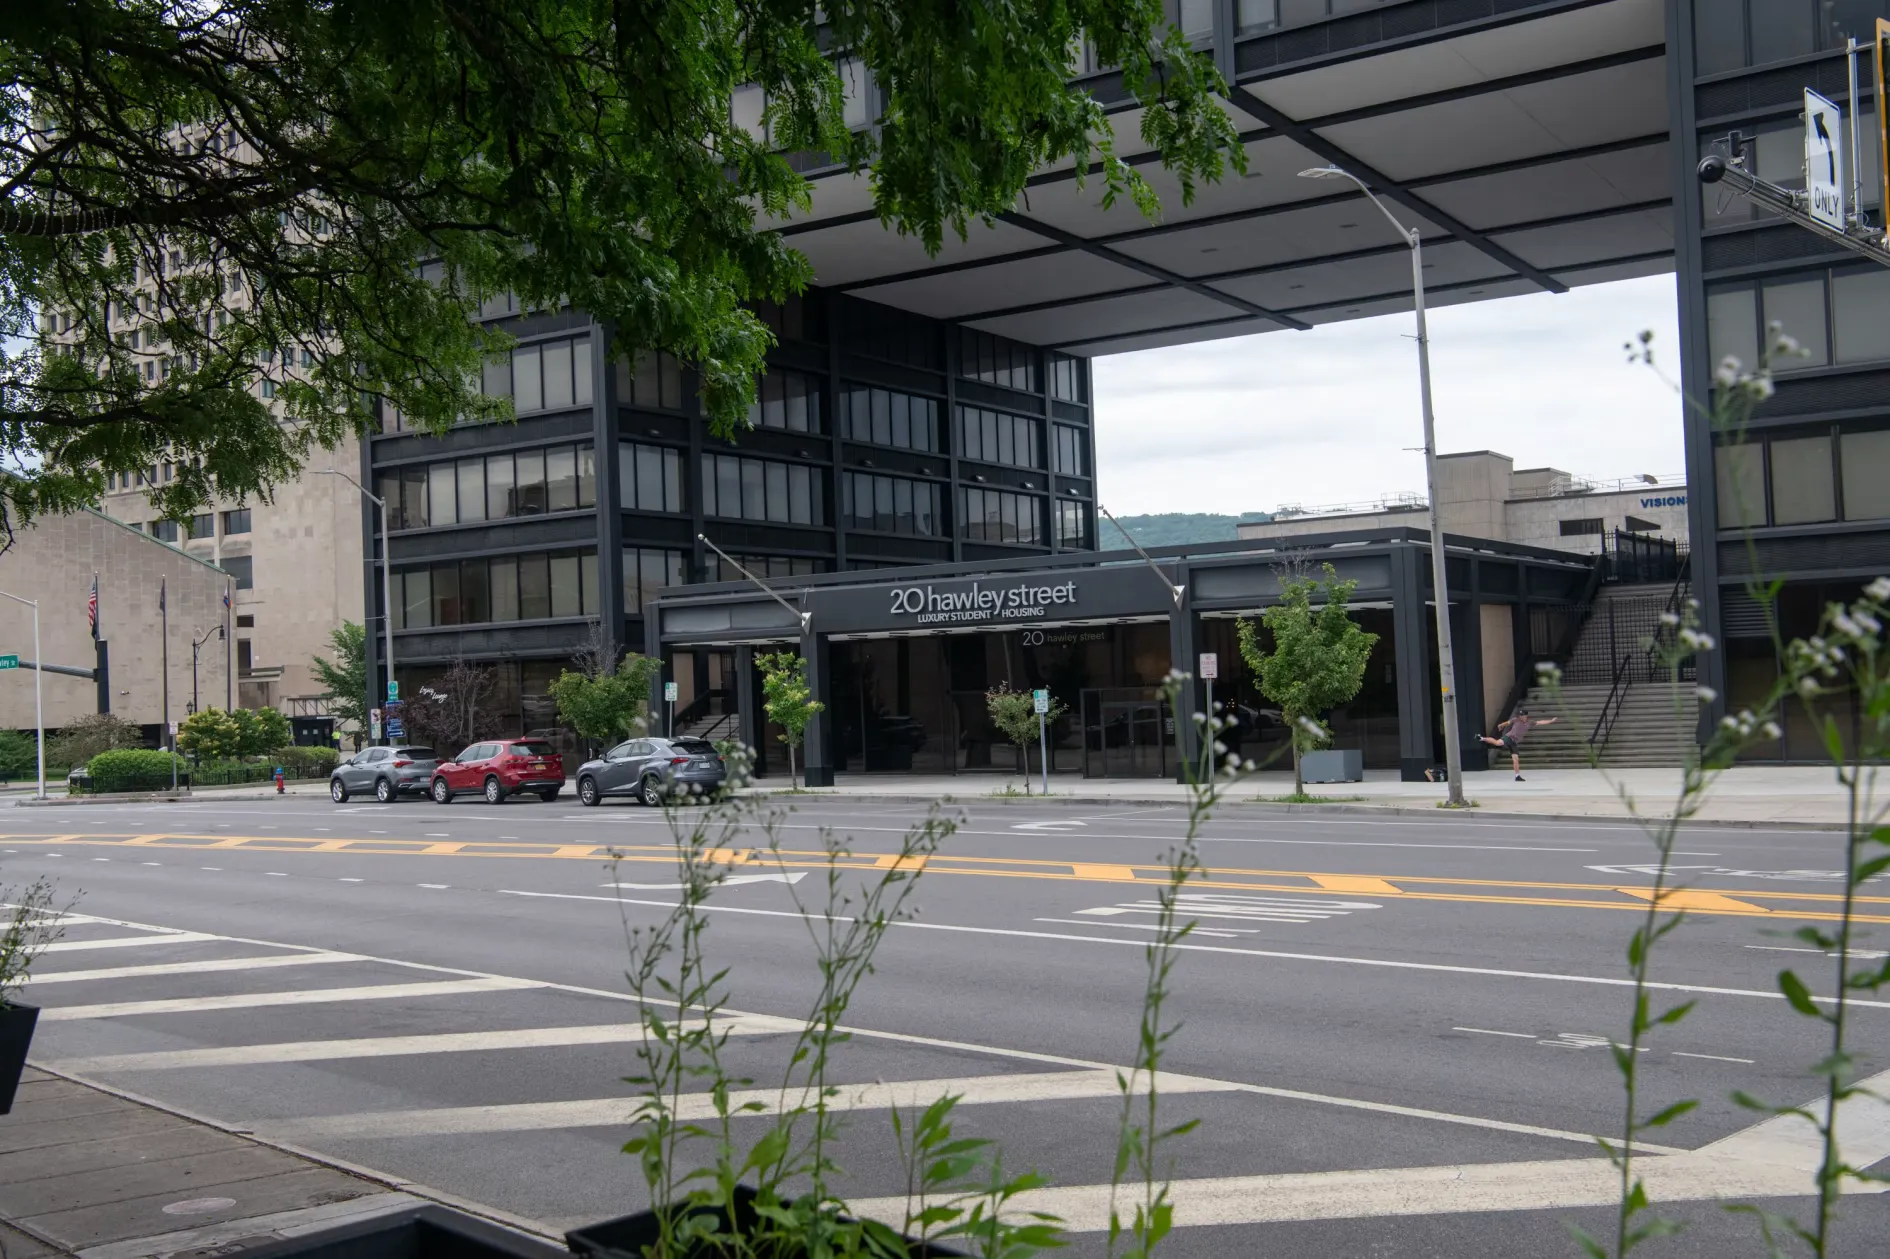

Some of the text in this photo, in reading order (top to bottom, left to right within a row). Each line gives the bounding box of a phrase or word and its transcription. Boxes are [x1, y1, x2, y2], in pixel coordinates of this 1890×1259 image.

[1815, 186, 1839, 218] ONLY
[890, 581, 1076, 614] 20 hawley street
[917, 607, 1044, 623] LUXURY STUDENT HOUSING
[1023, 631, 1104, 646] 20 hawley street
